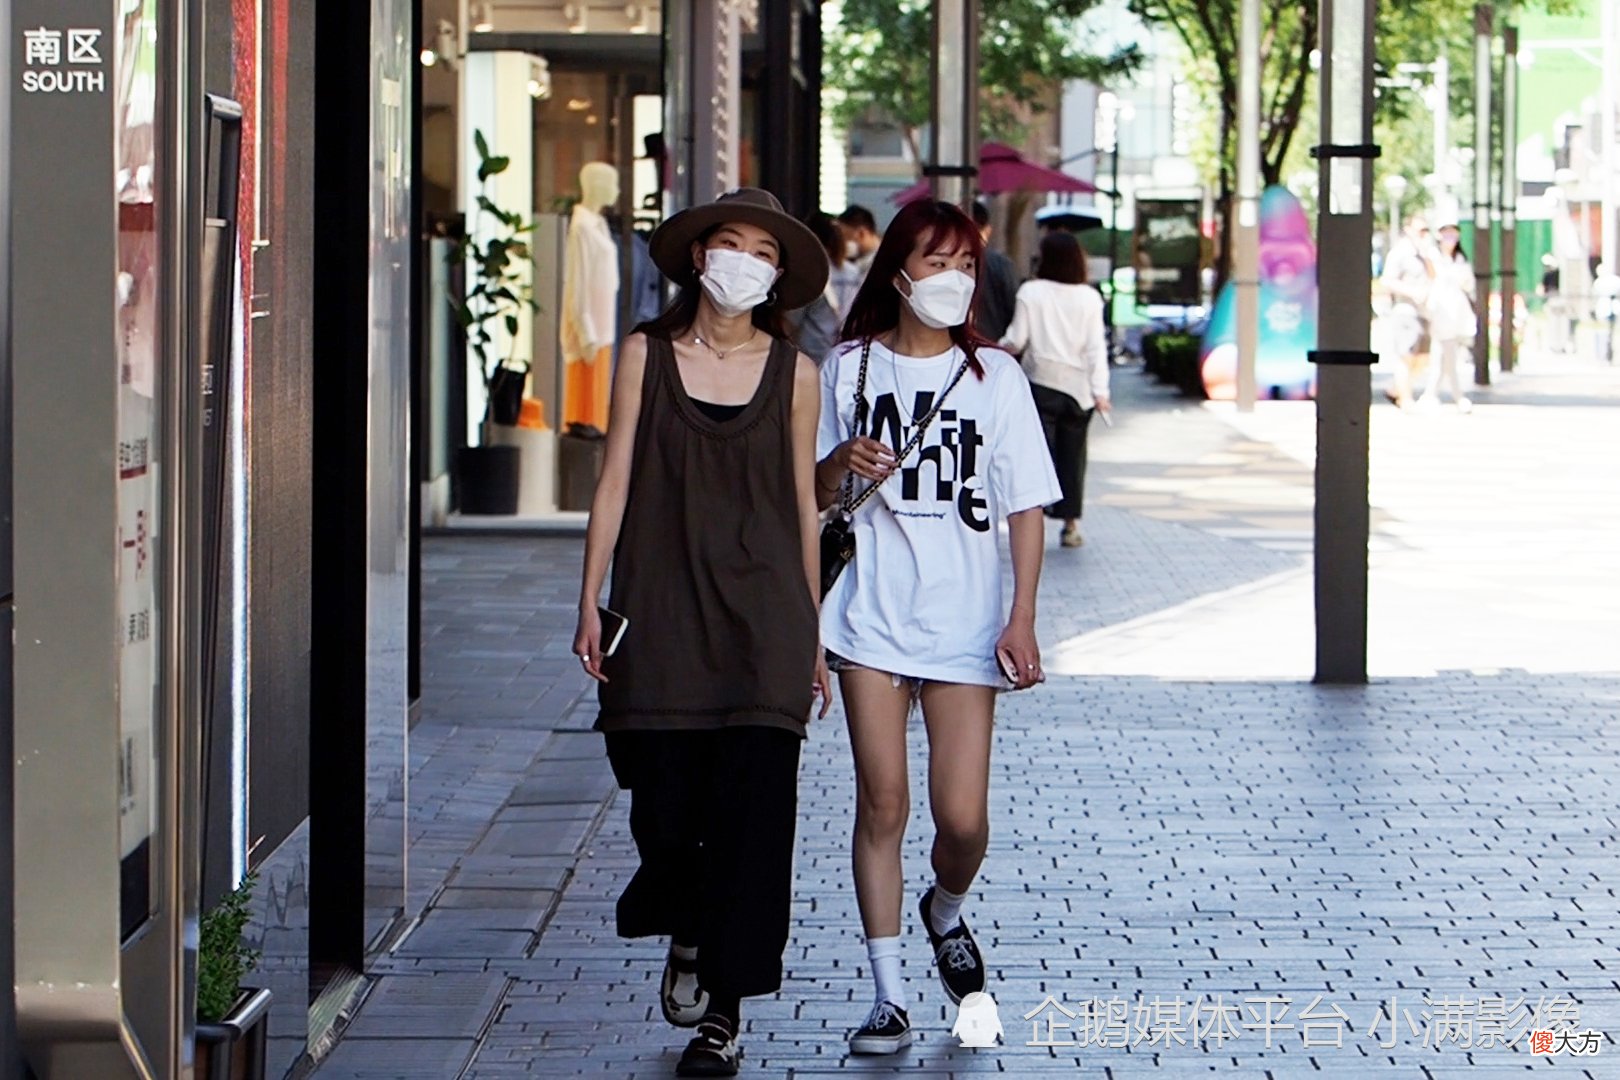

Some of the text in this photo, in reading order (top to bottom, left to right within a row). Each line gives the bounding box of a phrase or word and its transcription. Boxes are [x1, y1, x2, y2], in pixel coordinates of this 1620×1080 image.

[23, 26, 102, 65] 南区
[22, 70, 104, 92] SOUTH
[858, 390, 990, 532] White
